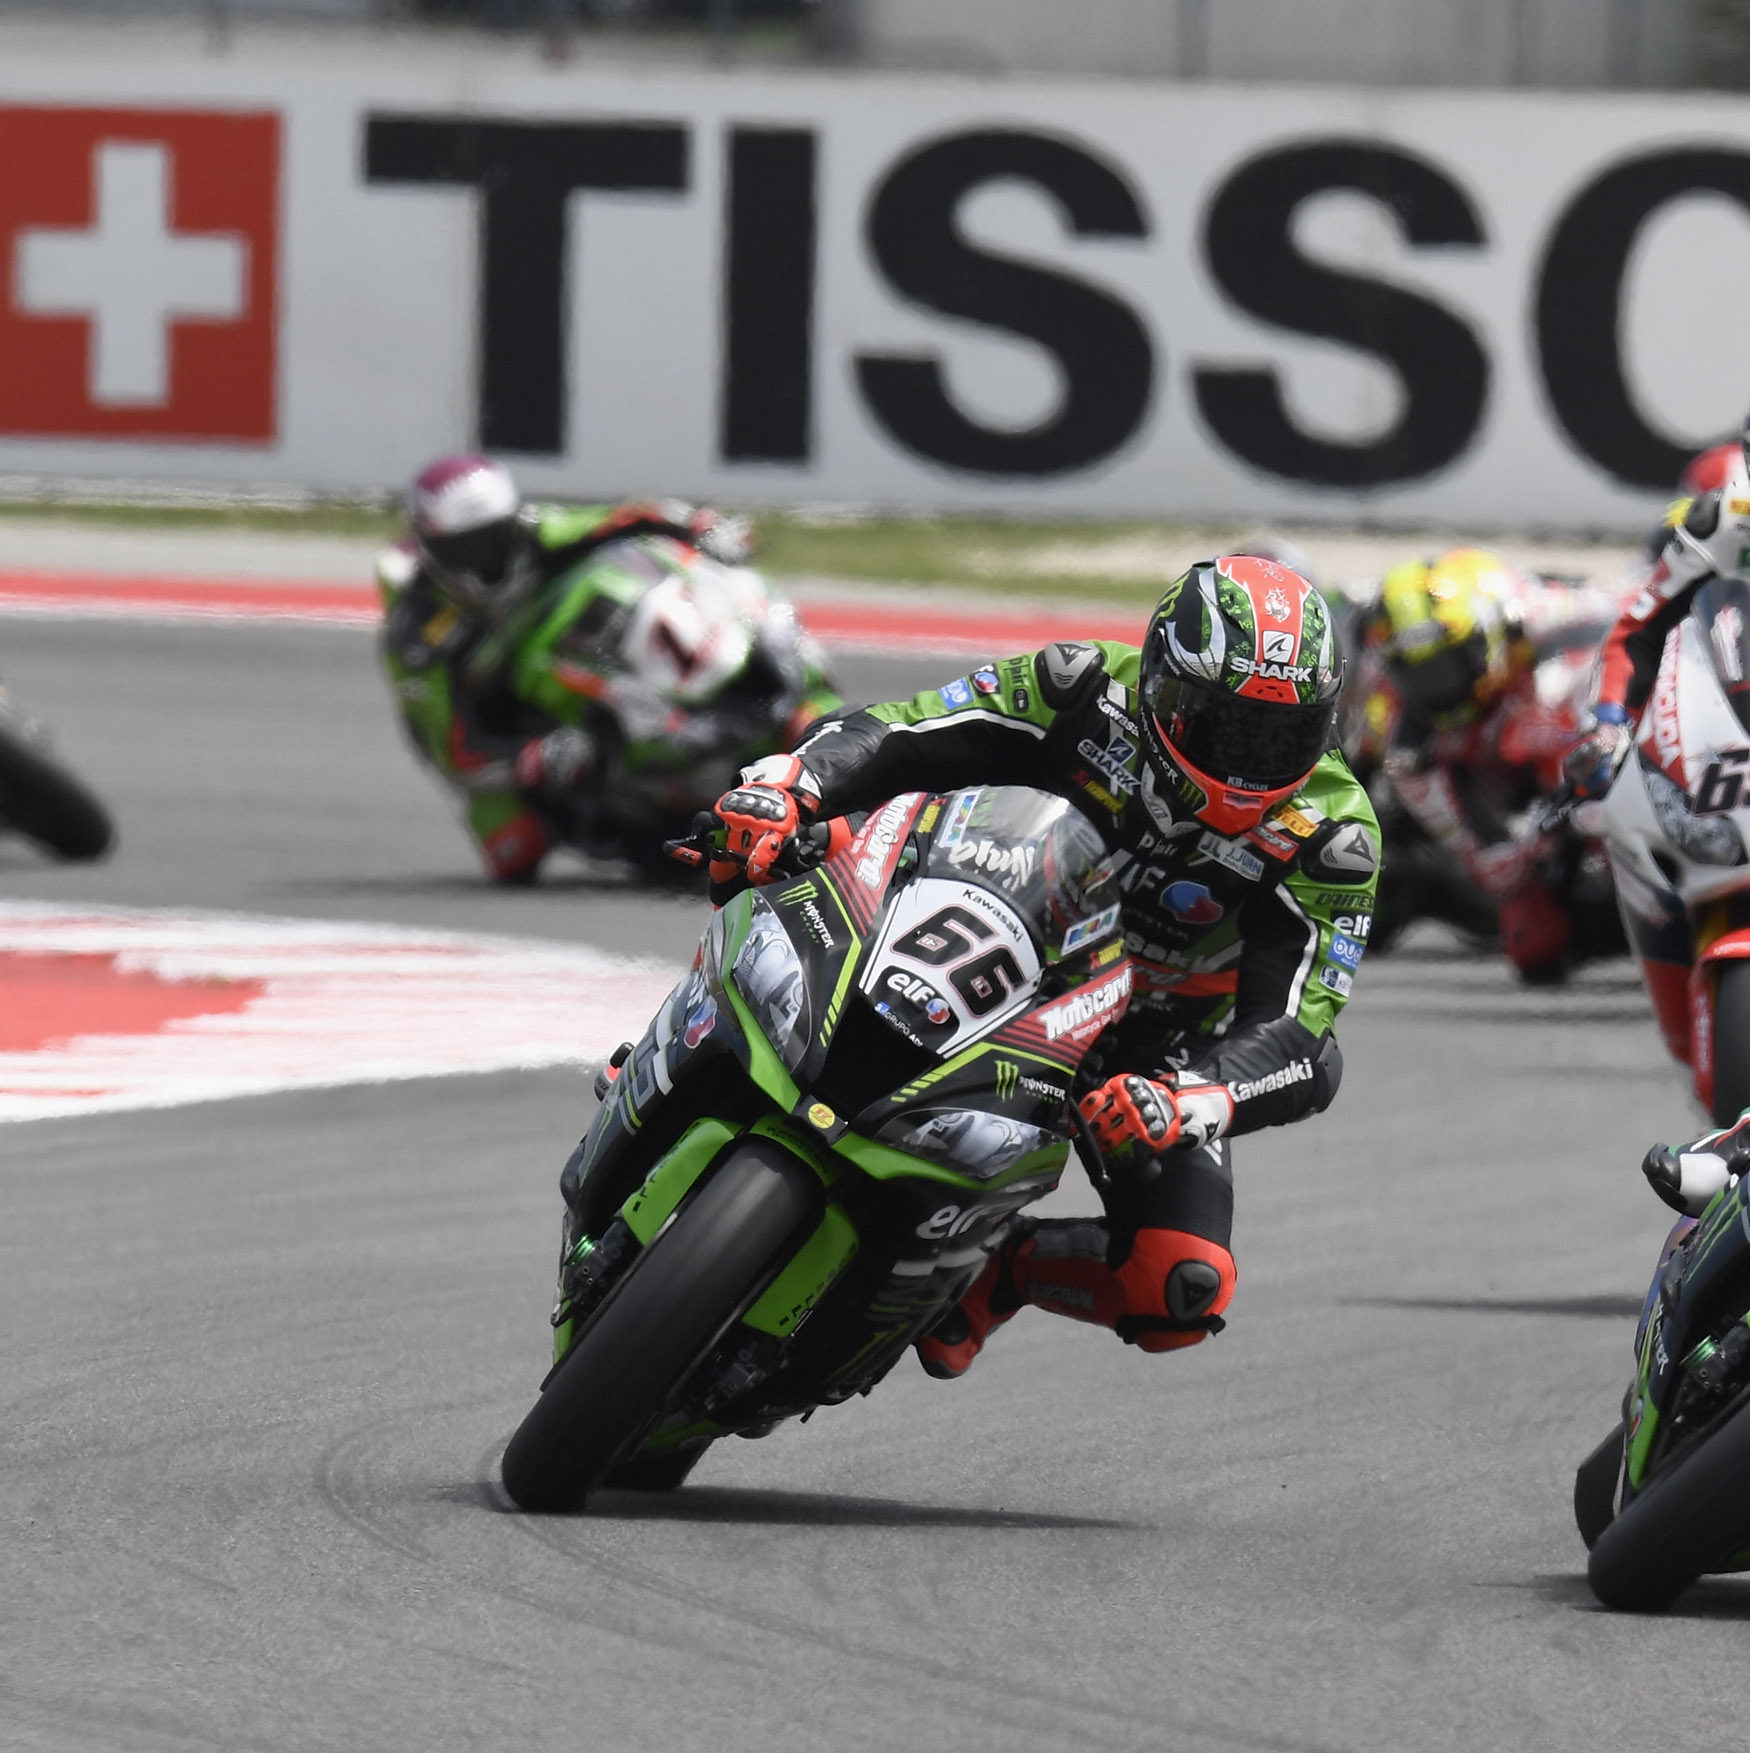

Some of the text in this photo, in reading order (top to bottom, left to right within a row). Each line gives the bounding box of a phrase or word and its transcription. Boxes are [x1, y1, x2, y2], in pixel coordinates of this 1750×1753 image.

[1229, 656, 1313, 683] SHARK
[1077, 739, 1141, 796] SHARK
[803, 900, 835, 949] MONSTER
[961, 888, 1025, 945] Kawasaki
[890, 903, 1030, 1019] 66
[886, 972, 936, 1003] elf
[1038, 967, 1133, 1042] Motocard
[884, 1011, 911, 1036] GRUPO
[1019, 1076, 1067, 1102] MONSTER
[1227, 1057, 1314, 1103] Kawasaki
